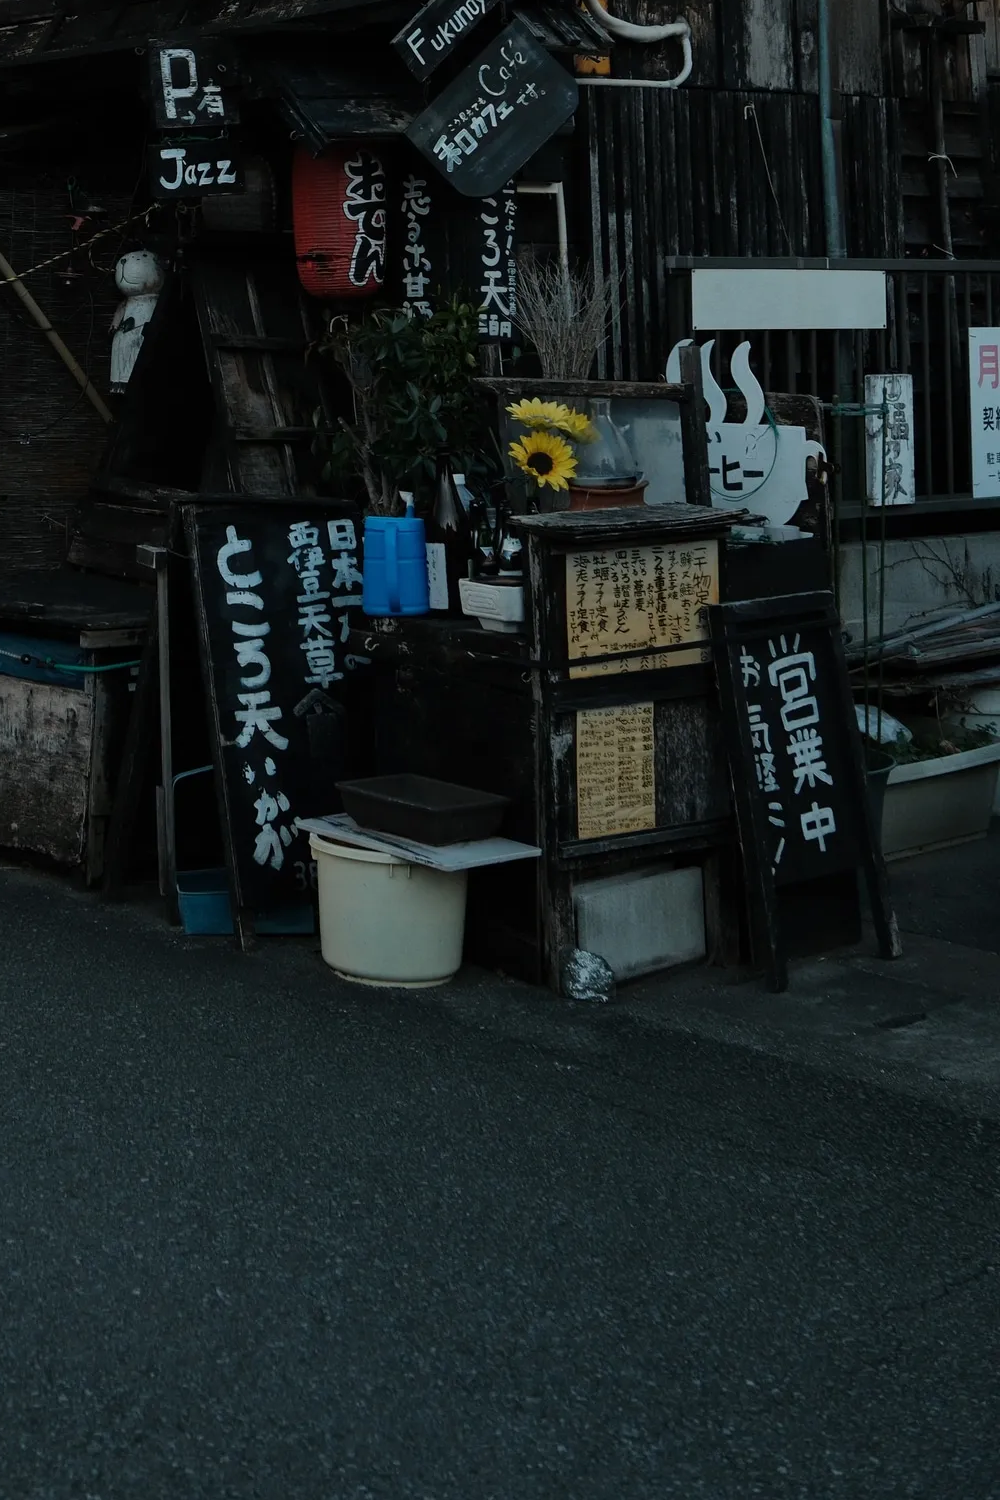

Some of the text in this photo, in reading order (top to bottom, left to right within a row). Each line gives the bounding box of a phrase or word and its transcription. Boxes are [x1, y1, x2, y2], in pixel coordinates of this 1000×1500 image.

[160, 48, 200, 120] P
[159, 147, 236, 190] Jazz
[708, 454, 764, 491] ーヒー
[216, 523, 289, 751] ところ天
[287, 520, 345, 690] 西伊豆天草
[767, 632, 836, 852] 営業中
